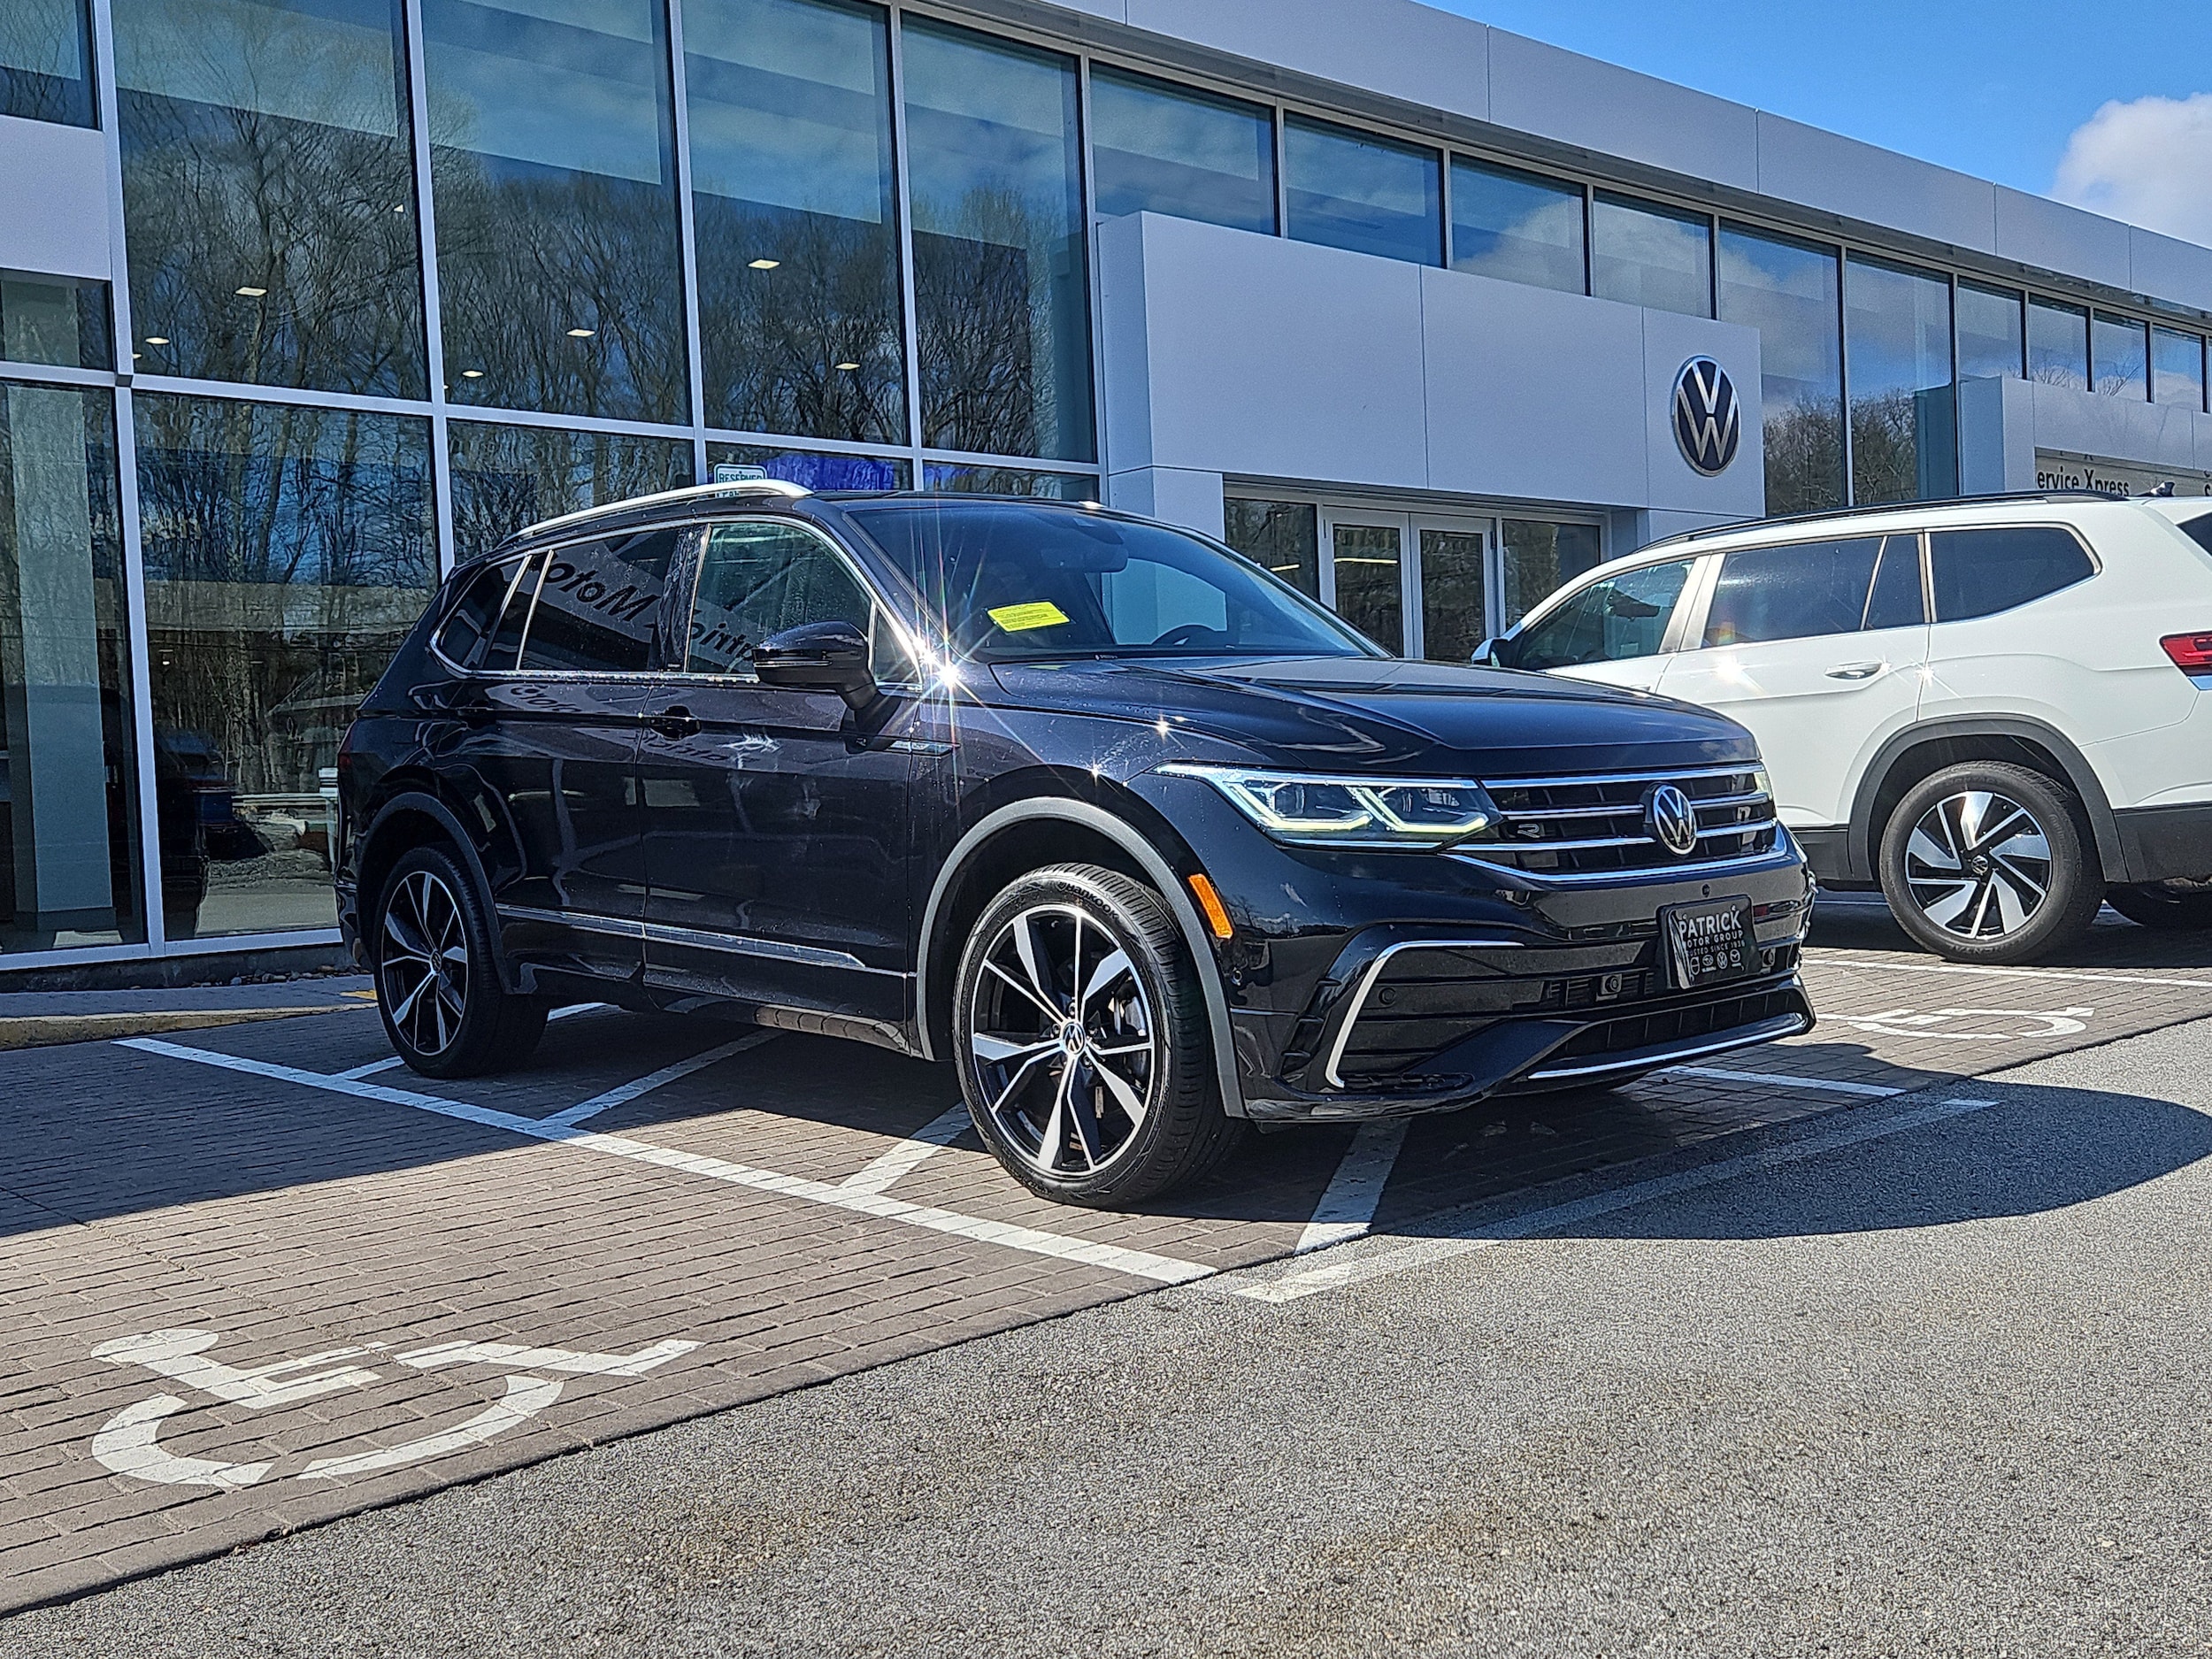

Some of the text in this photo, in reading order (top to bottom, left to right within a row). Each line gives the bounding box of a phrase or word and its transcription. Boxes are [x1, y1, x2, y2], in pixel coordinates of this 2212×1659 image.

[2037, 465, 2079, 491] ervice
[1678, 910, 1742, 938] PATRICK
[1685, 929, 1743, 948] OTOR GROUP
